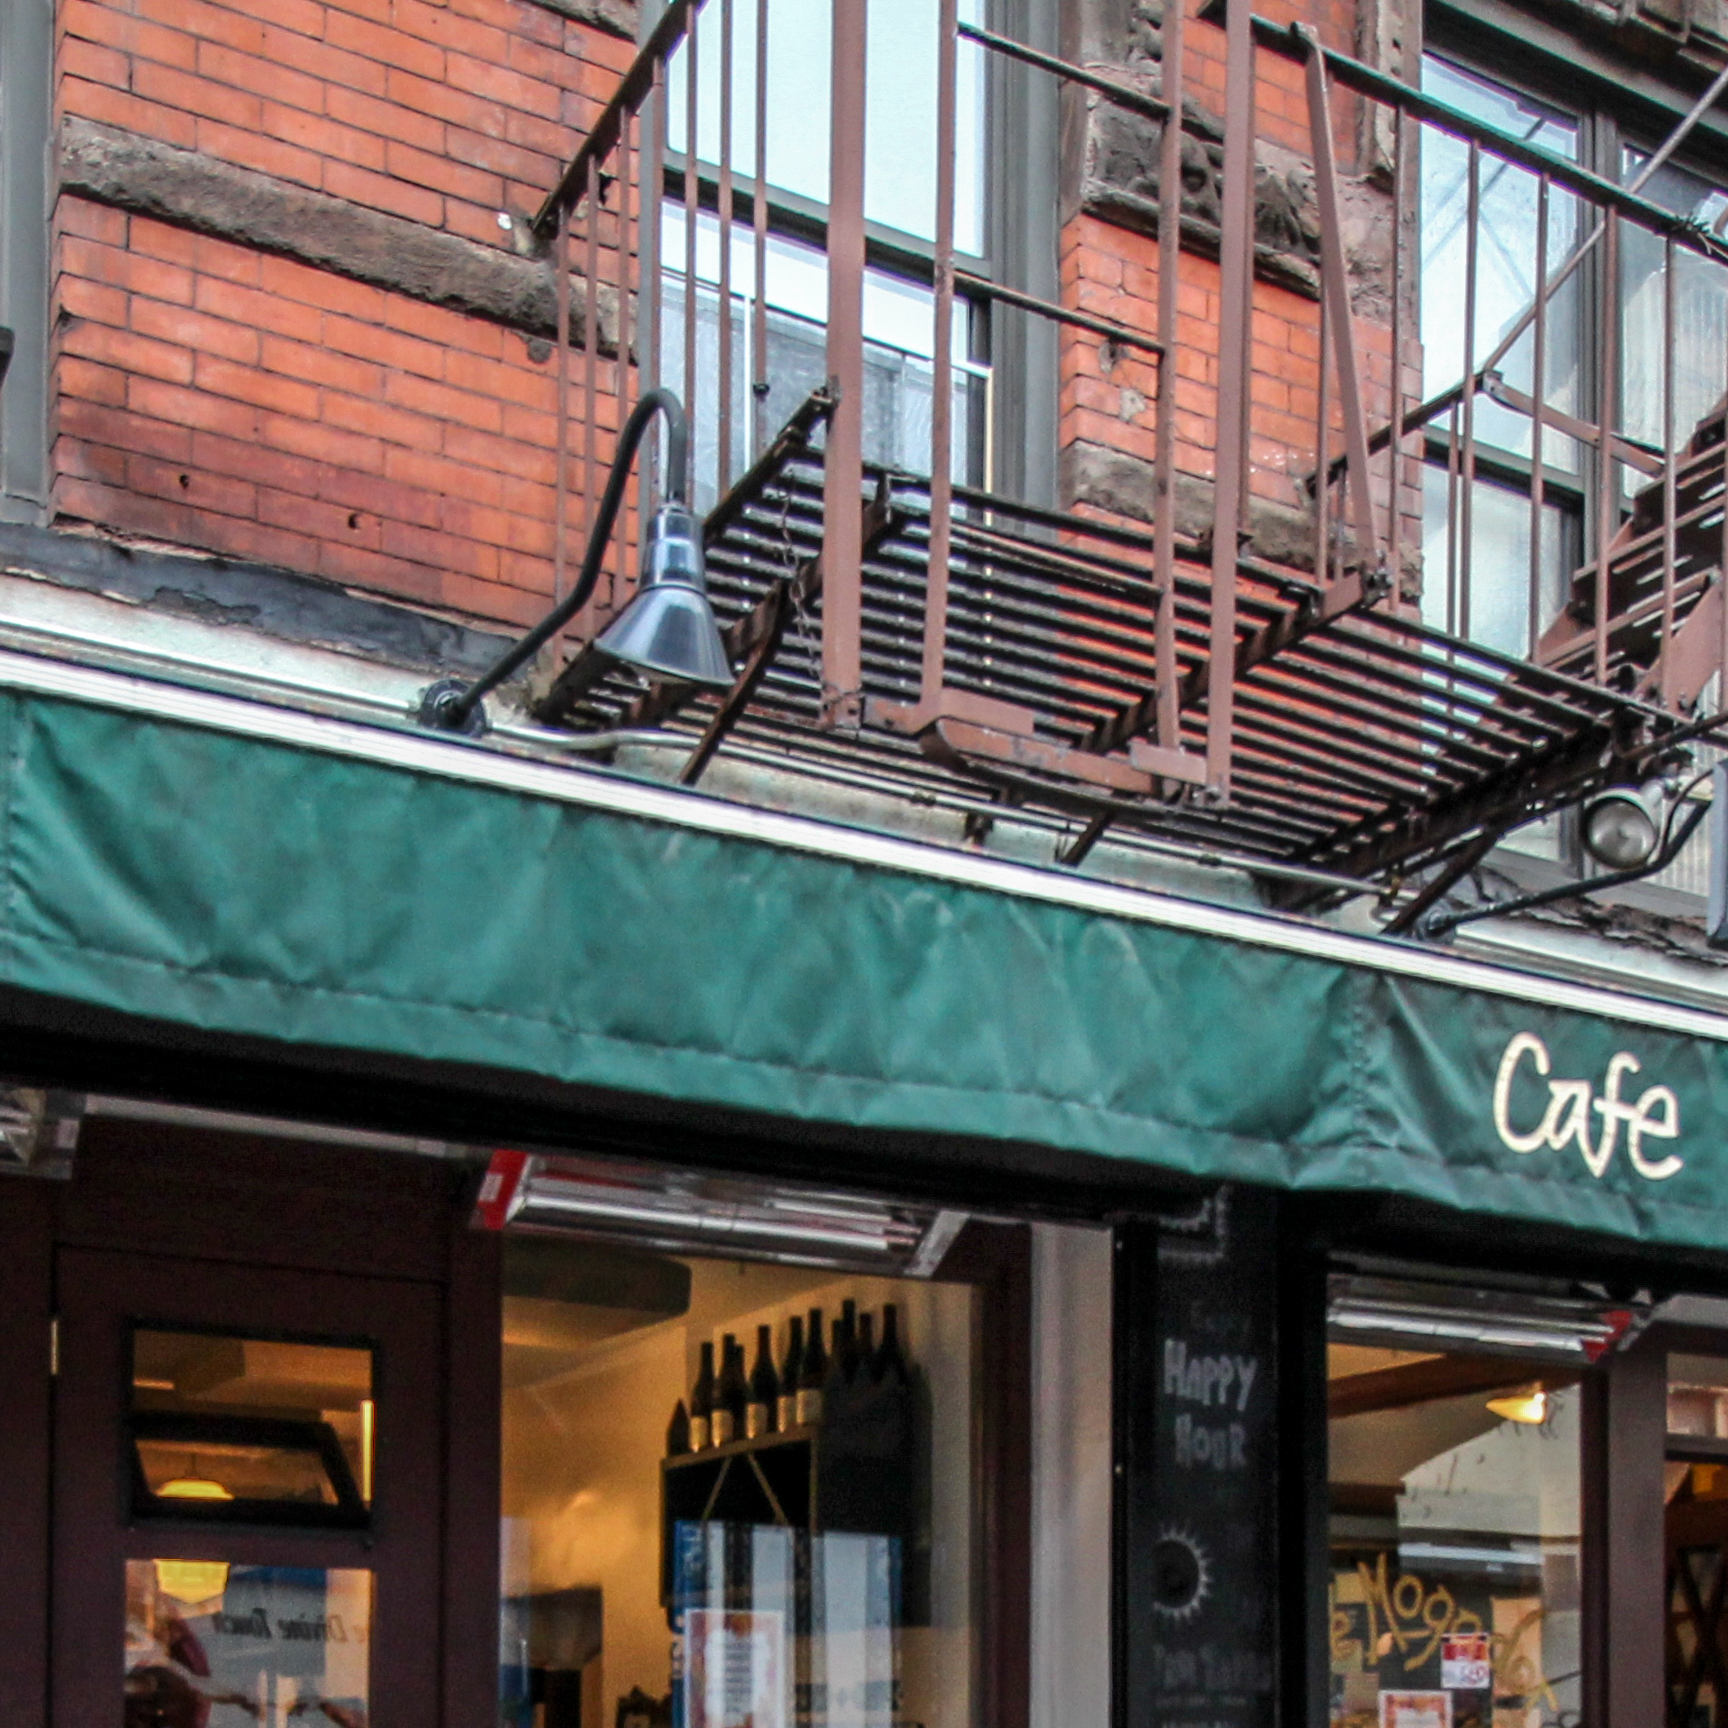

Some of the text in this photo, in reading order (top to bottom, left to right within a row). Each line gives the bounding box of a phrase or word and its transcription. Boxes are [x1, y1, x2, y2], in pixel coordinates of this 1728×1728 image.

[1491, 1030, 1684, 1181] Cafe
[1164, 1337, 1258, 1412] HAPPY
[1175, 1413, 1248, 1471] HOUR
